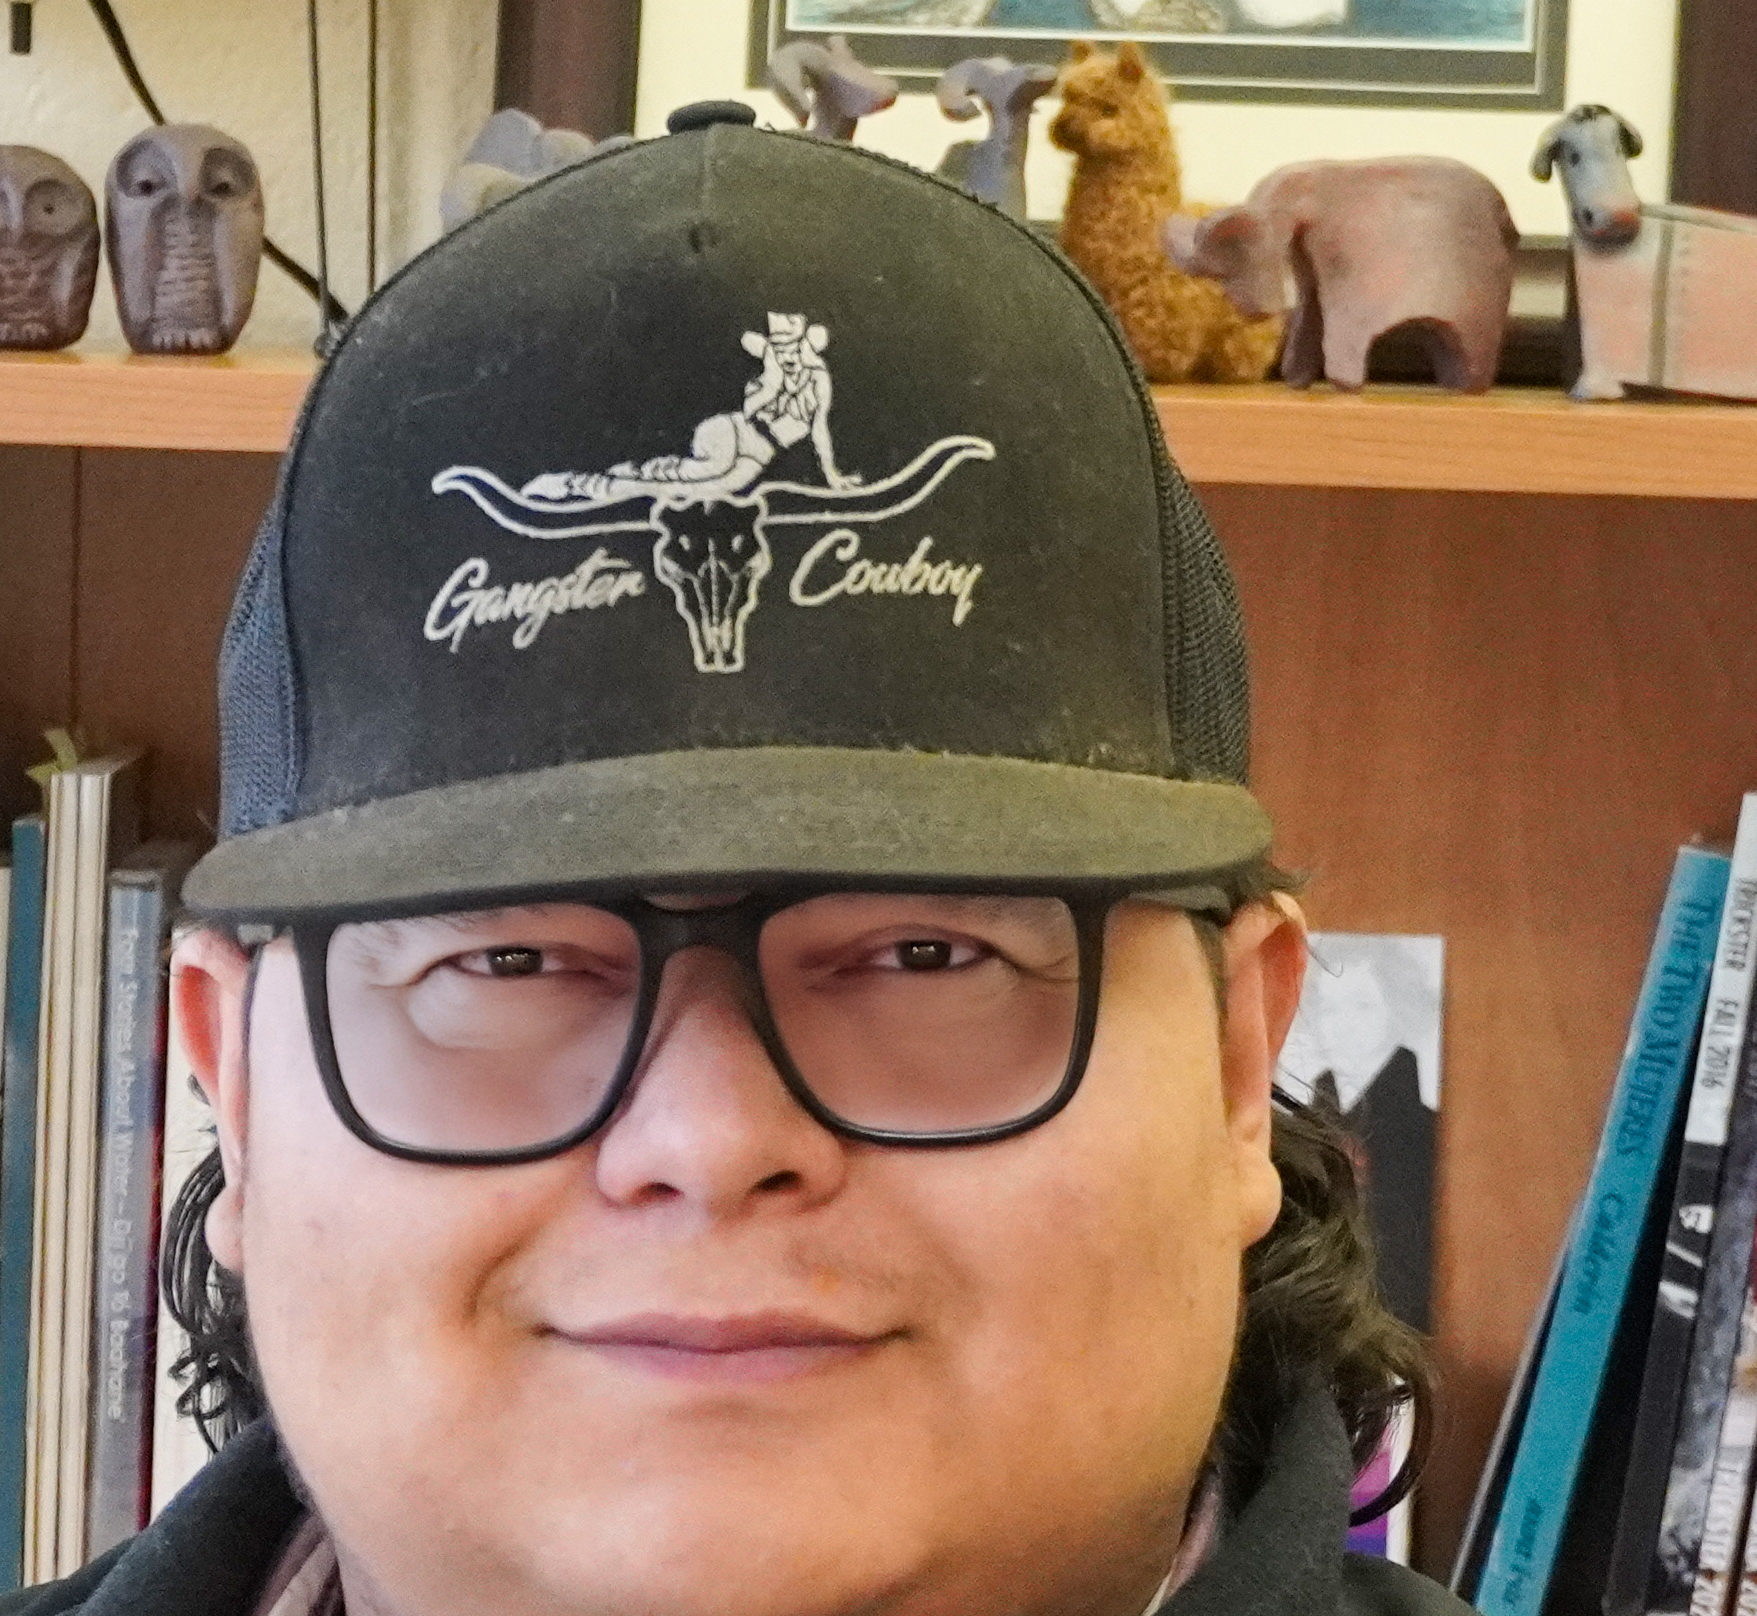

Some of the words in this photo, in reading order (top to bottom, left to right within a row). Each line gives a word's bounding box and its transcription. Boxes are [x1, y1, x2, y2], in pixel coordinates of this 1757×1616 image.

[424, 547, 646, 652] Gangster
[788, 529, 982, 625] Cowboy
[1670, 898, 1716, 955] THE
[115, 980, 138, 1053] Stories
[1648, 957, 1702, 1032] TWO
[1707, 998, 1739, 1044] FALL
[114, 1054, 136, 1127] About
[1614, 1032, 1680, 1159] MUJERES
[1700, 1044, 1732, 1091] 2016
[112, 1129, 134, 1197] Water
[1698, 1459, 1745, 1573] TRICKSTER
